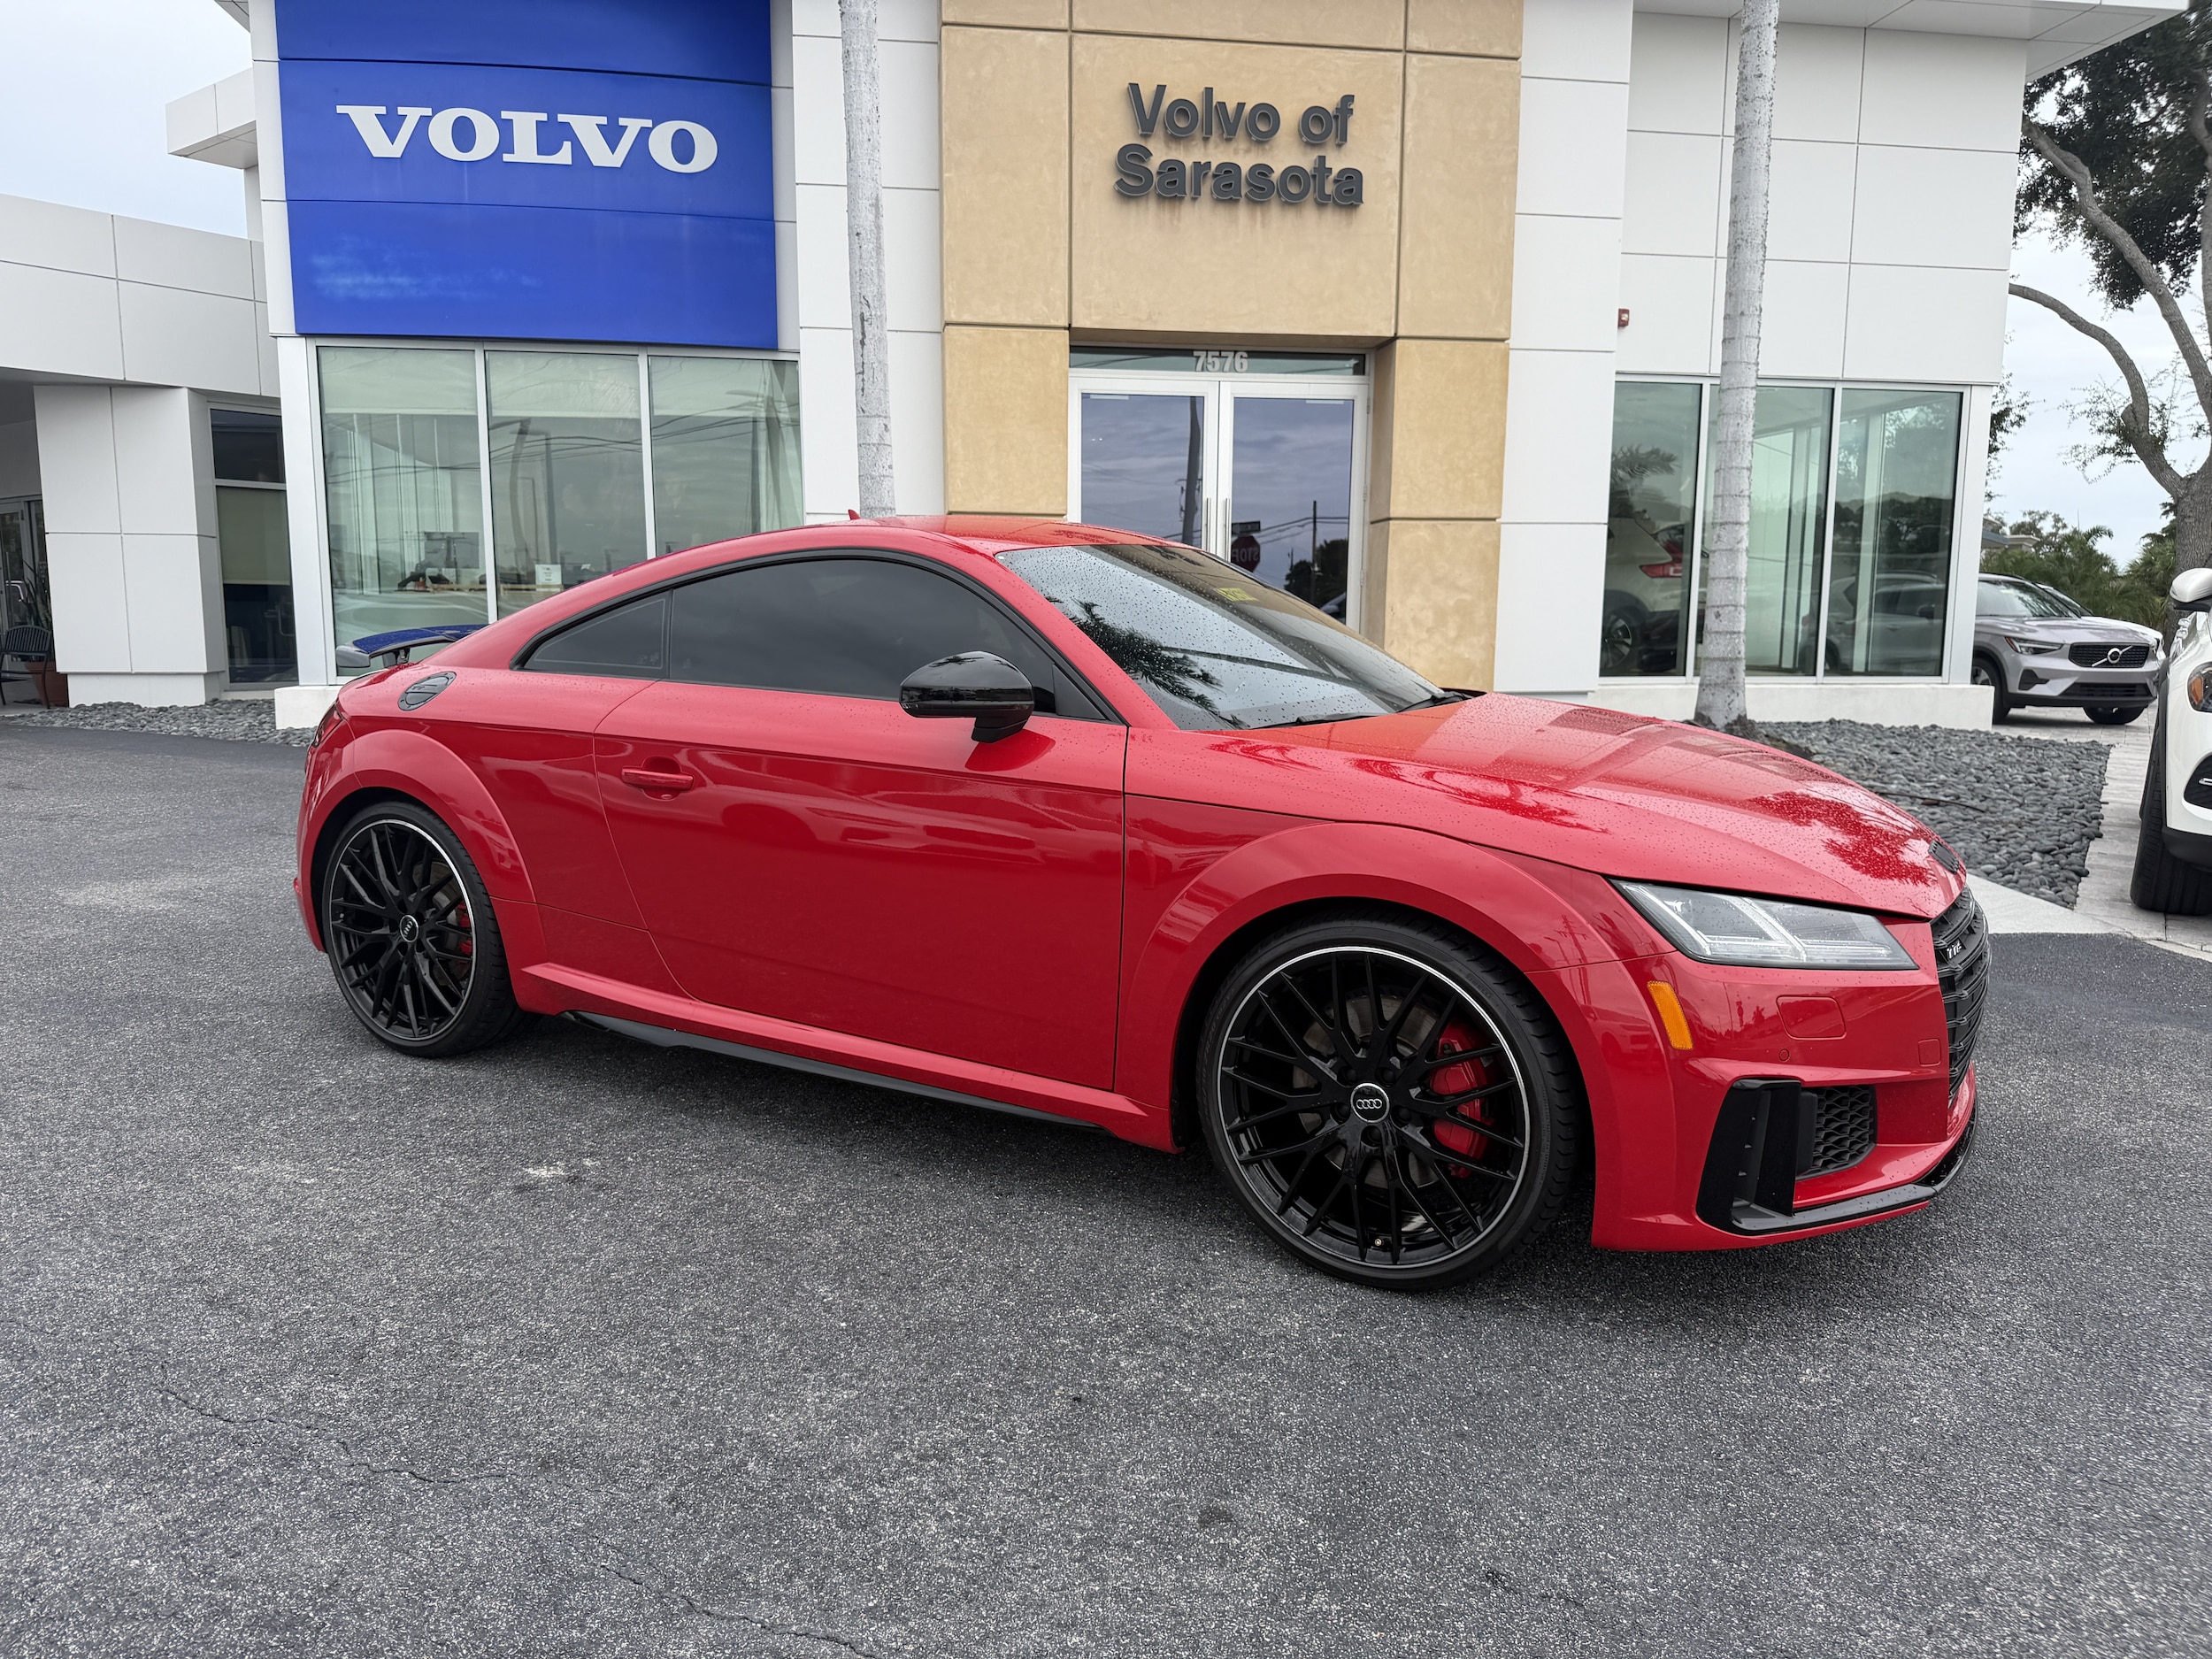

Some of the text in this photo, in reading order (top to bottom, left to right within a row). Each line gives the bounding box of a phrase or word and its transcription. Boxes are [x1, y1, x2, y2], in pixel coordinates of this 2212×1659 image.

[336, 104, 718, 173] VOLVO
[1127, 82, 1356, 145] Volvo of
[1114, 143, 1364, 205] Sarasota
[1193, 350, 1248, 373] 7576
